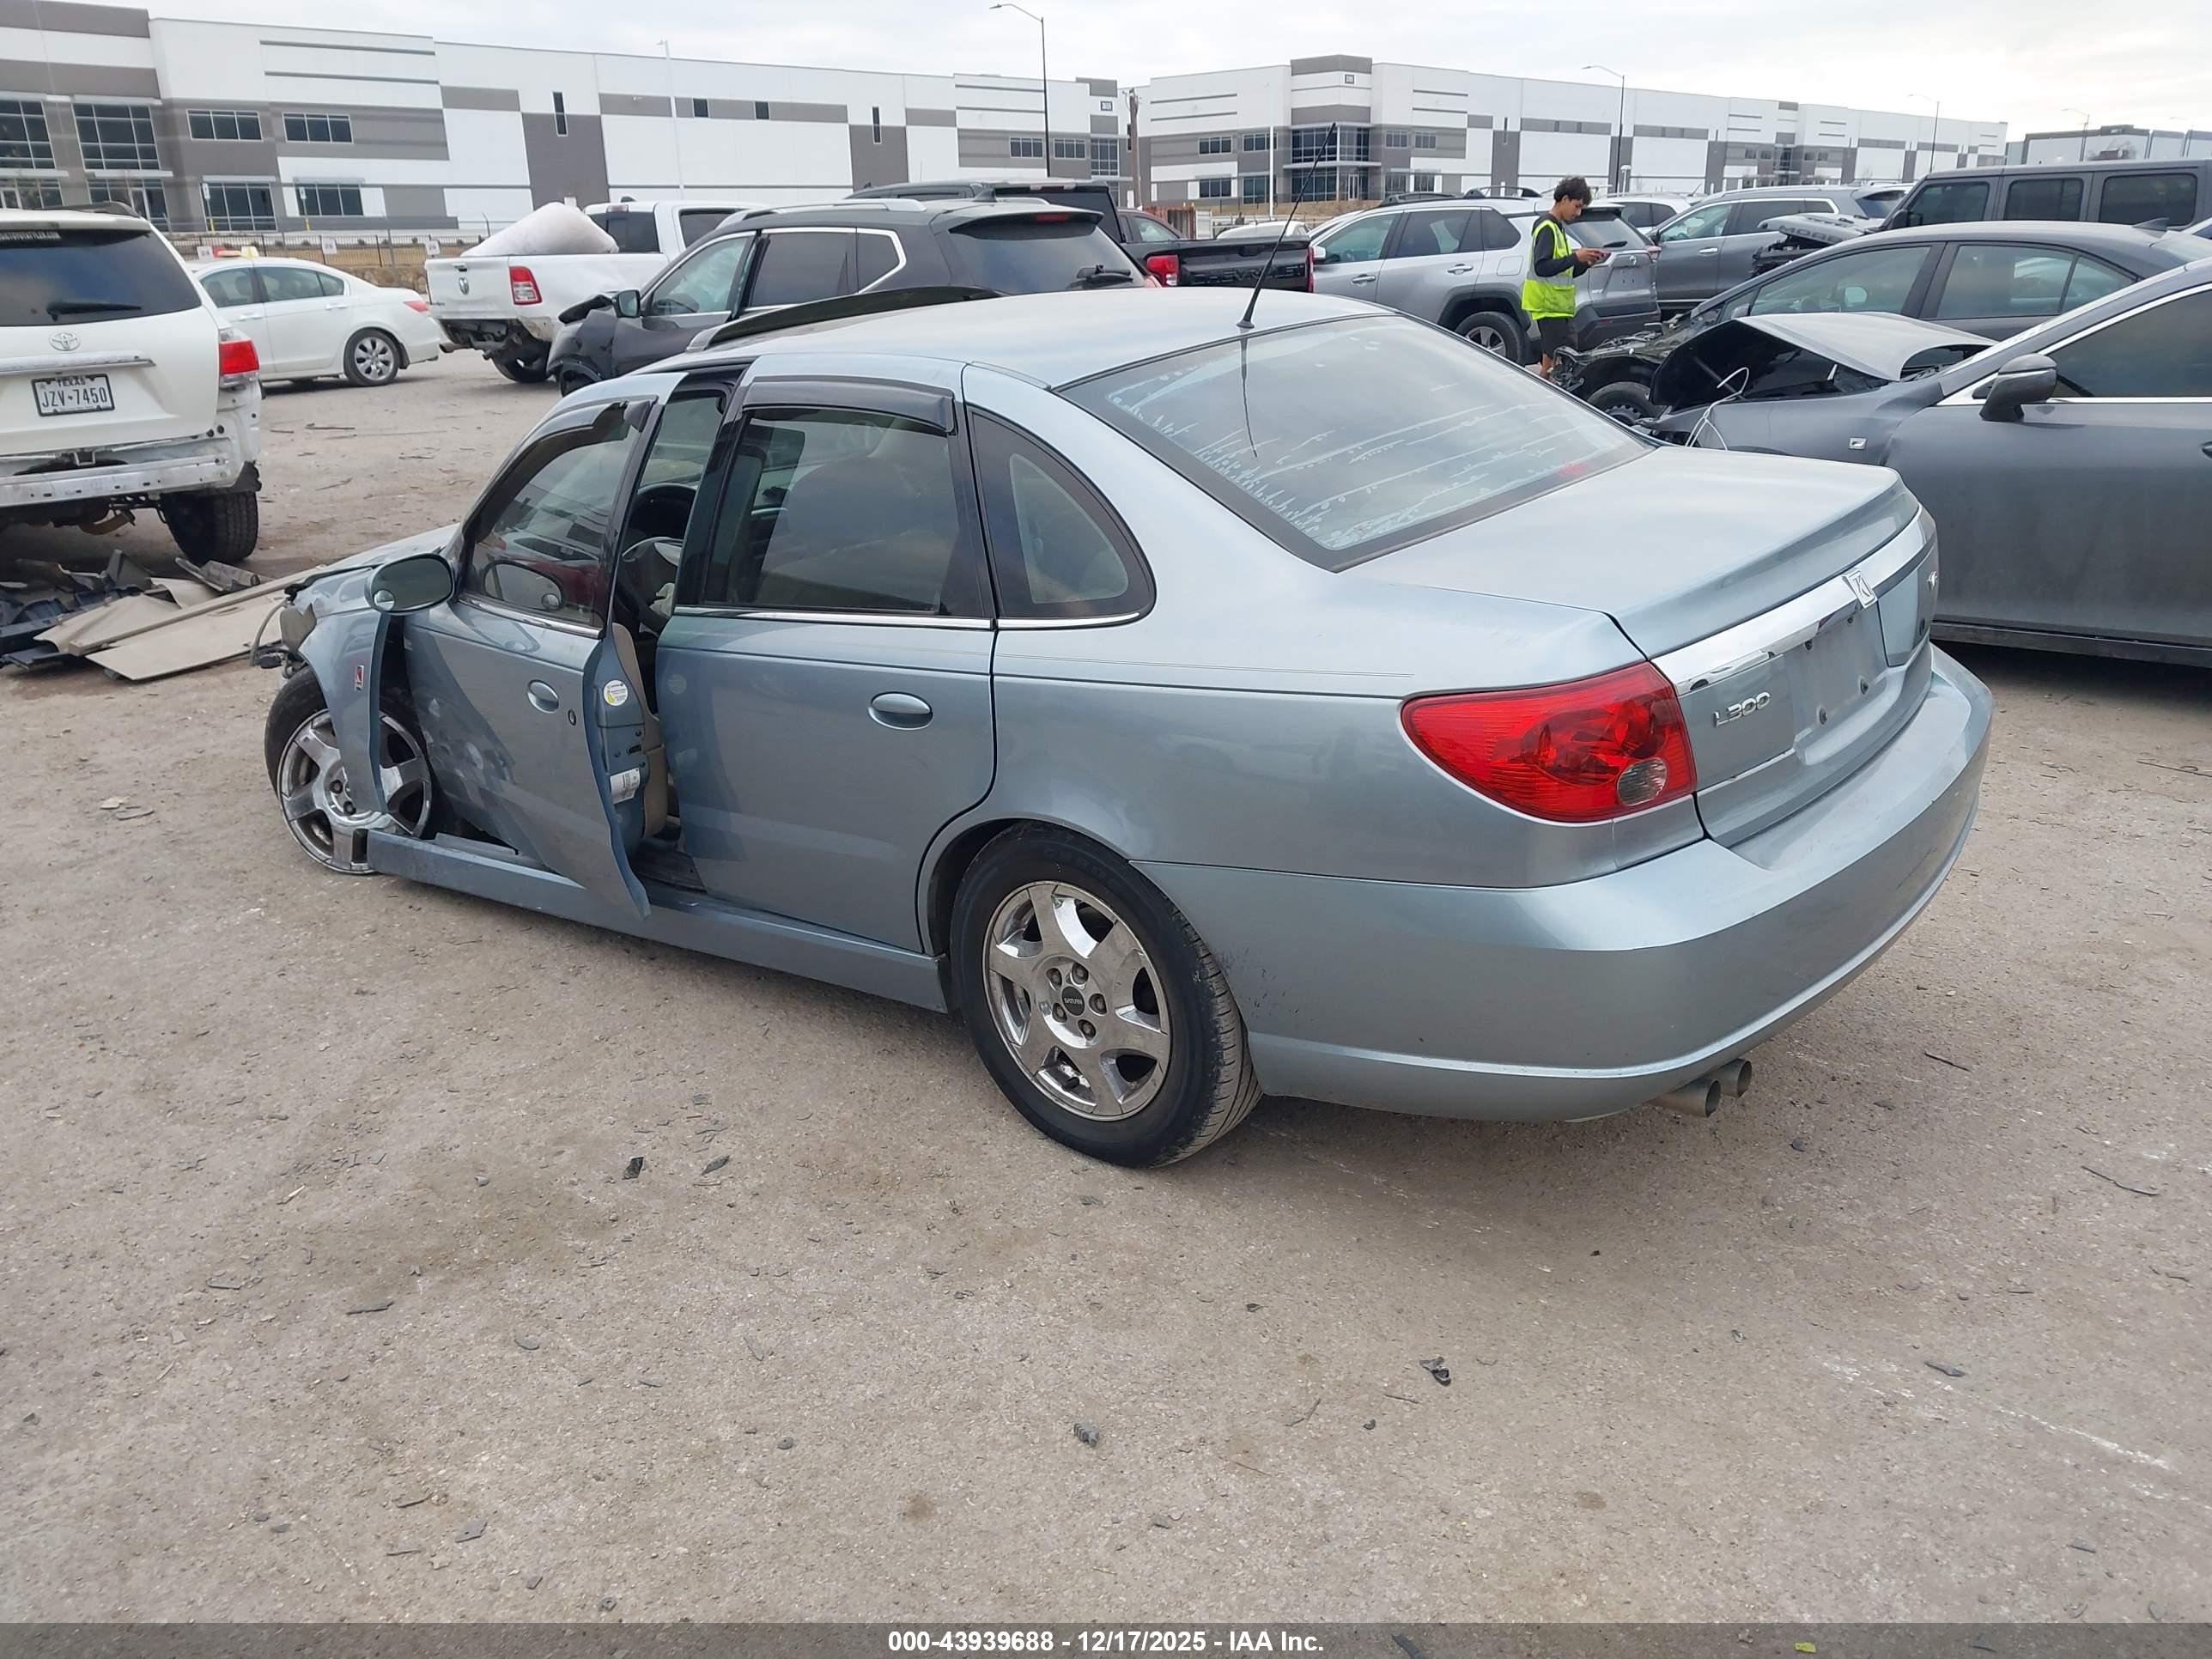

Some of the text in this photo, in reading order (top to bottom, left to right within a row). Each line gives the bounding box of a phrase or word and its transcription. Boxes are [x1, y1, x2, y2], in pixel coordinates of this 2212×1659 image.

[55, 376, 86, 386] TEXAS
[42, 386, 107, 408] JZV 7450
[1712, 691, 1771, 728] L300
